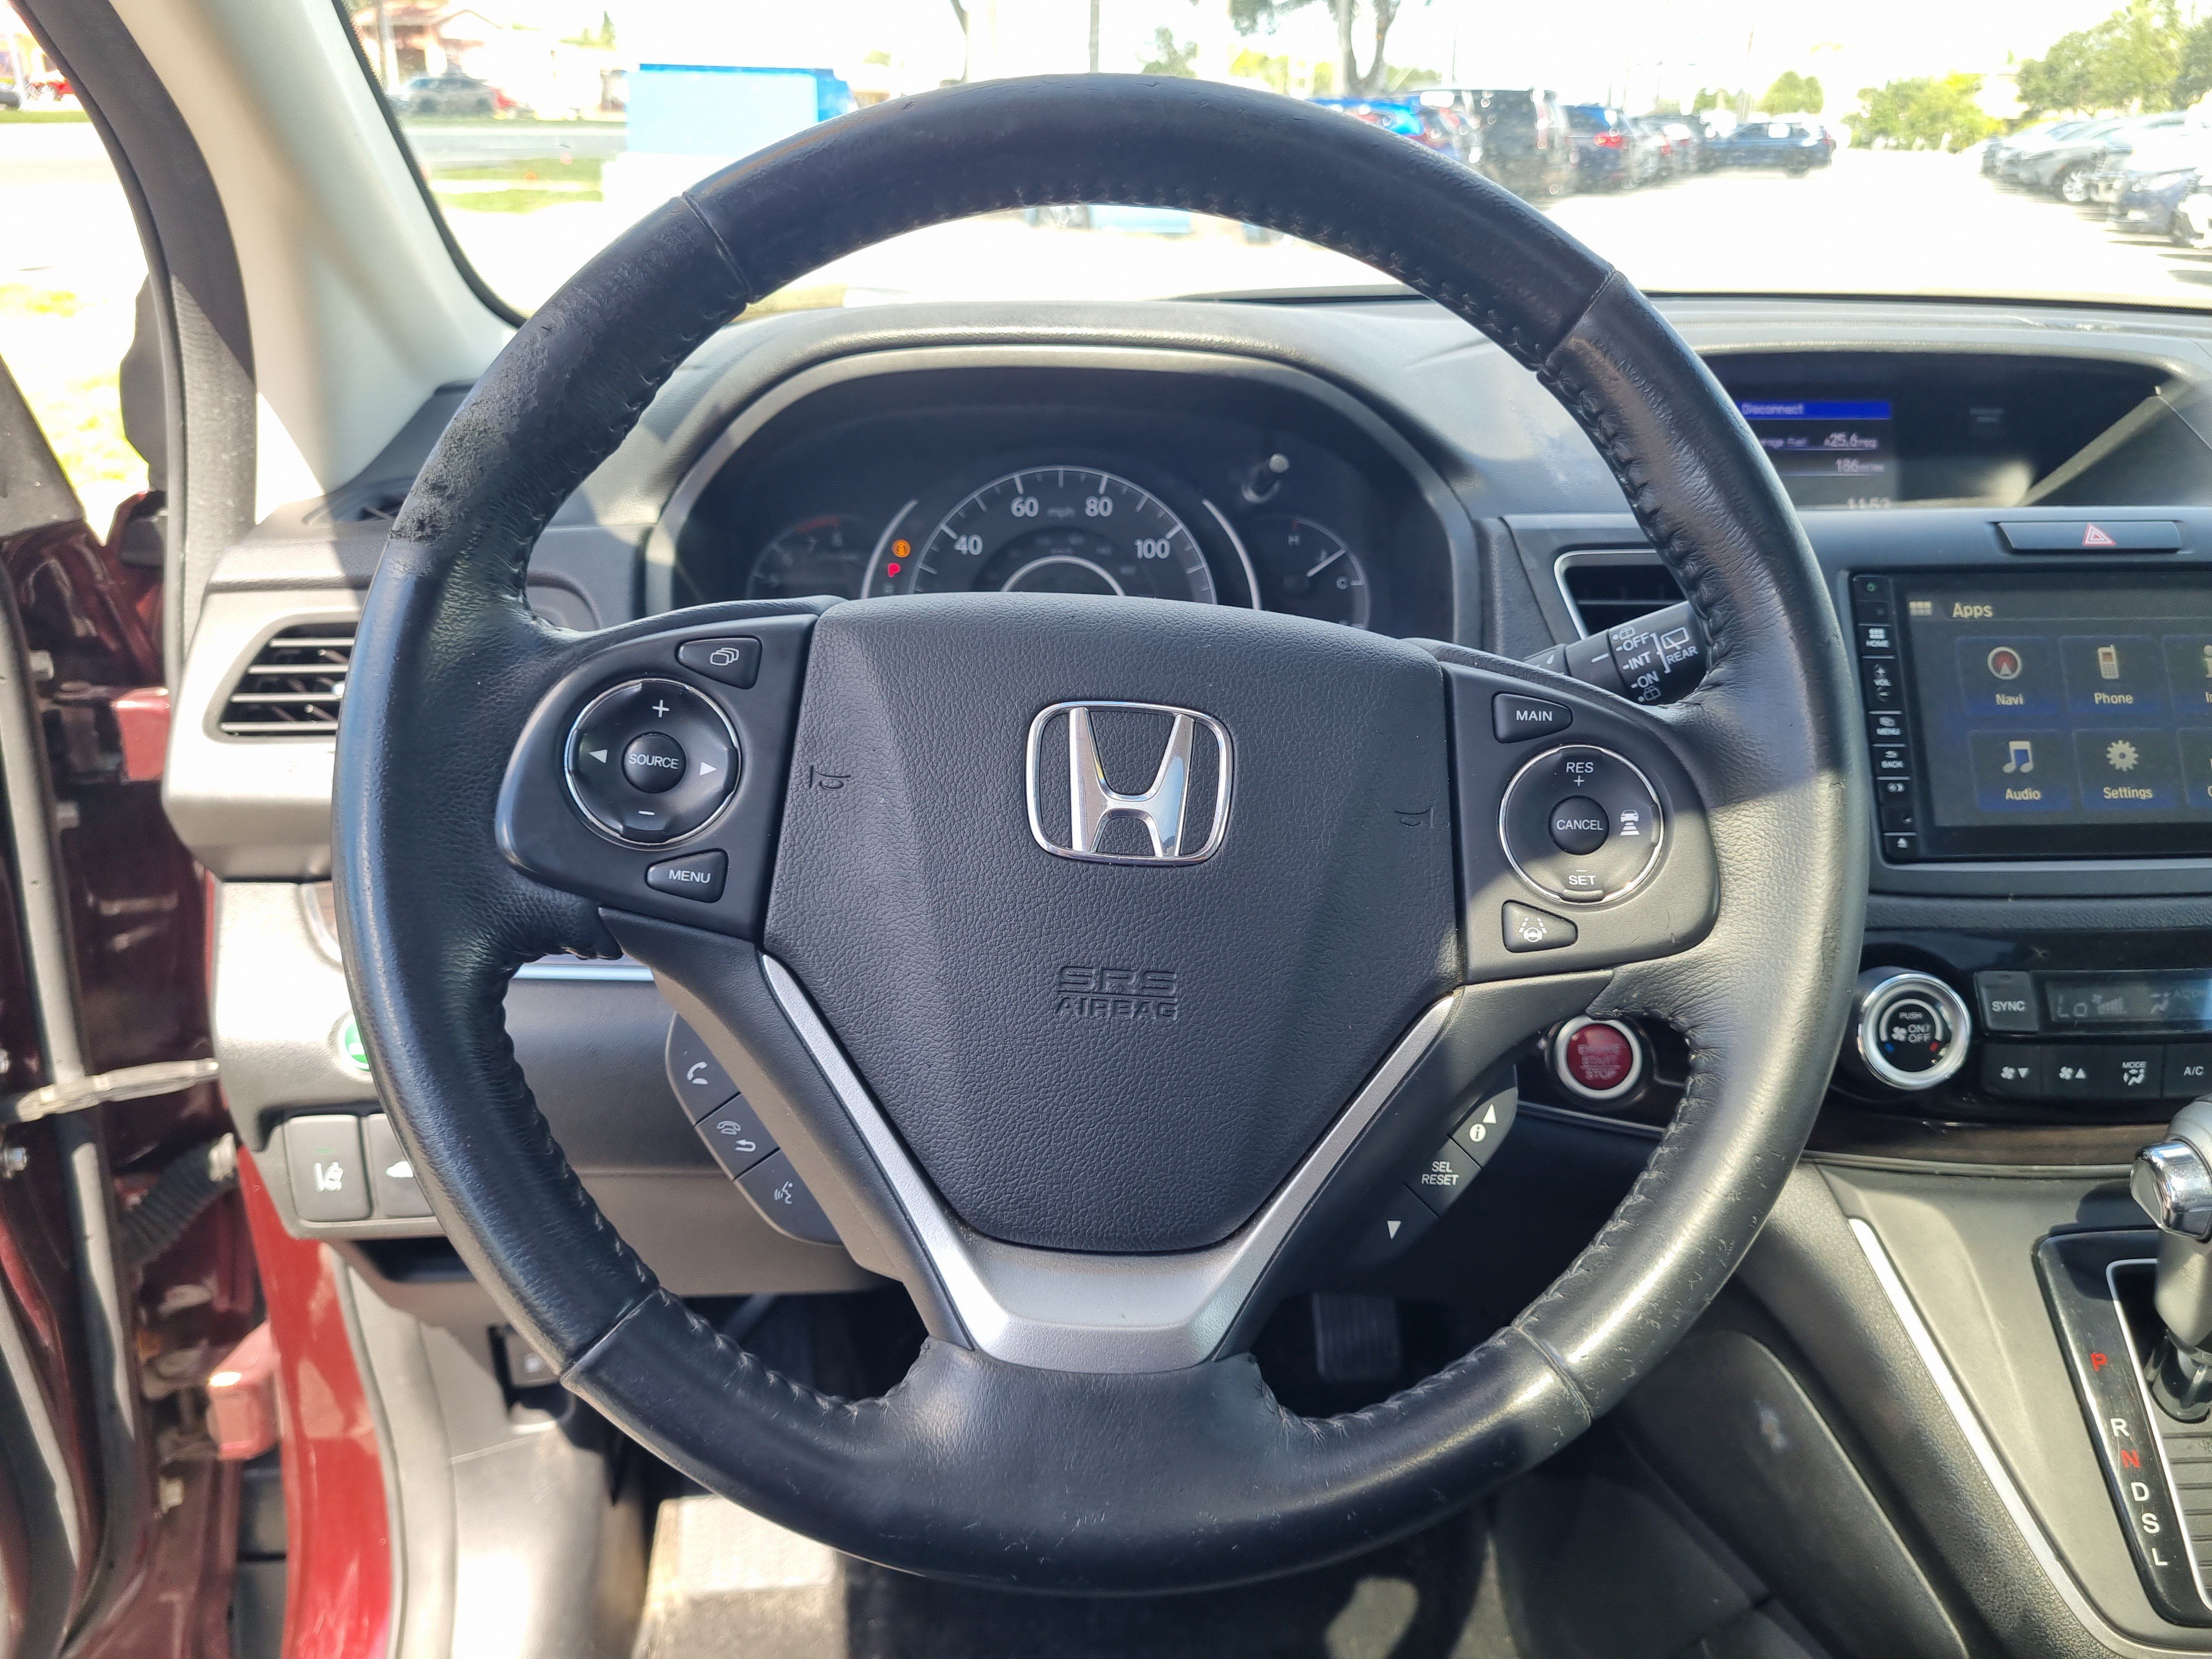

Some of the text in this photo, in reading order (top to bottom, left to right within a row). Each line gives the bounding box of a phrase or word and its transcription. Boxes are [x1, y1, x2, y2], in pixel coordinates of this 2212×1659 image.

[1011, 496, 1040, 517] 60
[1085, 495, 1114, 517] 80
[954, 534, 983, 556] 40
[1135, 538, 1171, 559] 100
[888, 562, 901, 577] P
[1952, 603, 1993, 618] Apps
[1622, 632, 1650, 651] OFF
[1628, 651, 1651, 670] INT
[1666, 645, 1700, 665] REAR
[1637, 670, 1660, 689] ON
[1995, 693, 2024, 706] Navi
[2094, 692, 2134, 706] Phone
[1515, 710, 1553, 723] MAIN
[628, 753, 679, 769] SOURCE
[1565, 761, 1594, 774] RES
[2005, 788, 2041, 801] Audio
[2103, 787, 2153, 801] Settings
[1556, 819, 1604, 831] CANCEL
[668, 870, 711, 884] MENU
[1568, 874, 1596, 886] SET
[1060, 965, 1178, 996] SRS
[1054, 995, 1180, 1021] AIRBAG
[1991, 1000, 2025, 1013] SYNC
[1908, 1033, 1932, 1044] OFF
[2122, 1061, 2147, 1069] MODE
[2183, 1065, 2204, 1076] A/C
[1431, 1161, 1453, 1172] SEL
[1421, 1174, 1459, 1186] RESET
[2091, 1352, 2108, 1372] P
[2110, 1417, 2129, 1437] R
[2121, 1449, 2140, 1469] N
[2131, 1481, 2150, 1502] D
[2142, 1513, 2160, 1534] S
[2151, 1546, 2169, 1566] L
